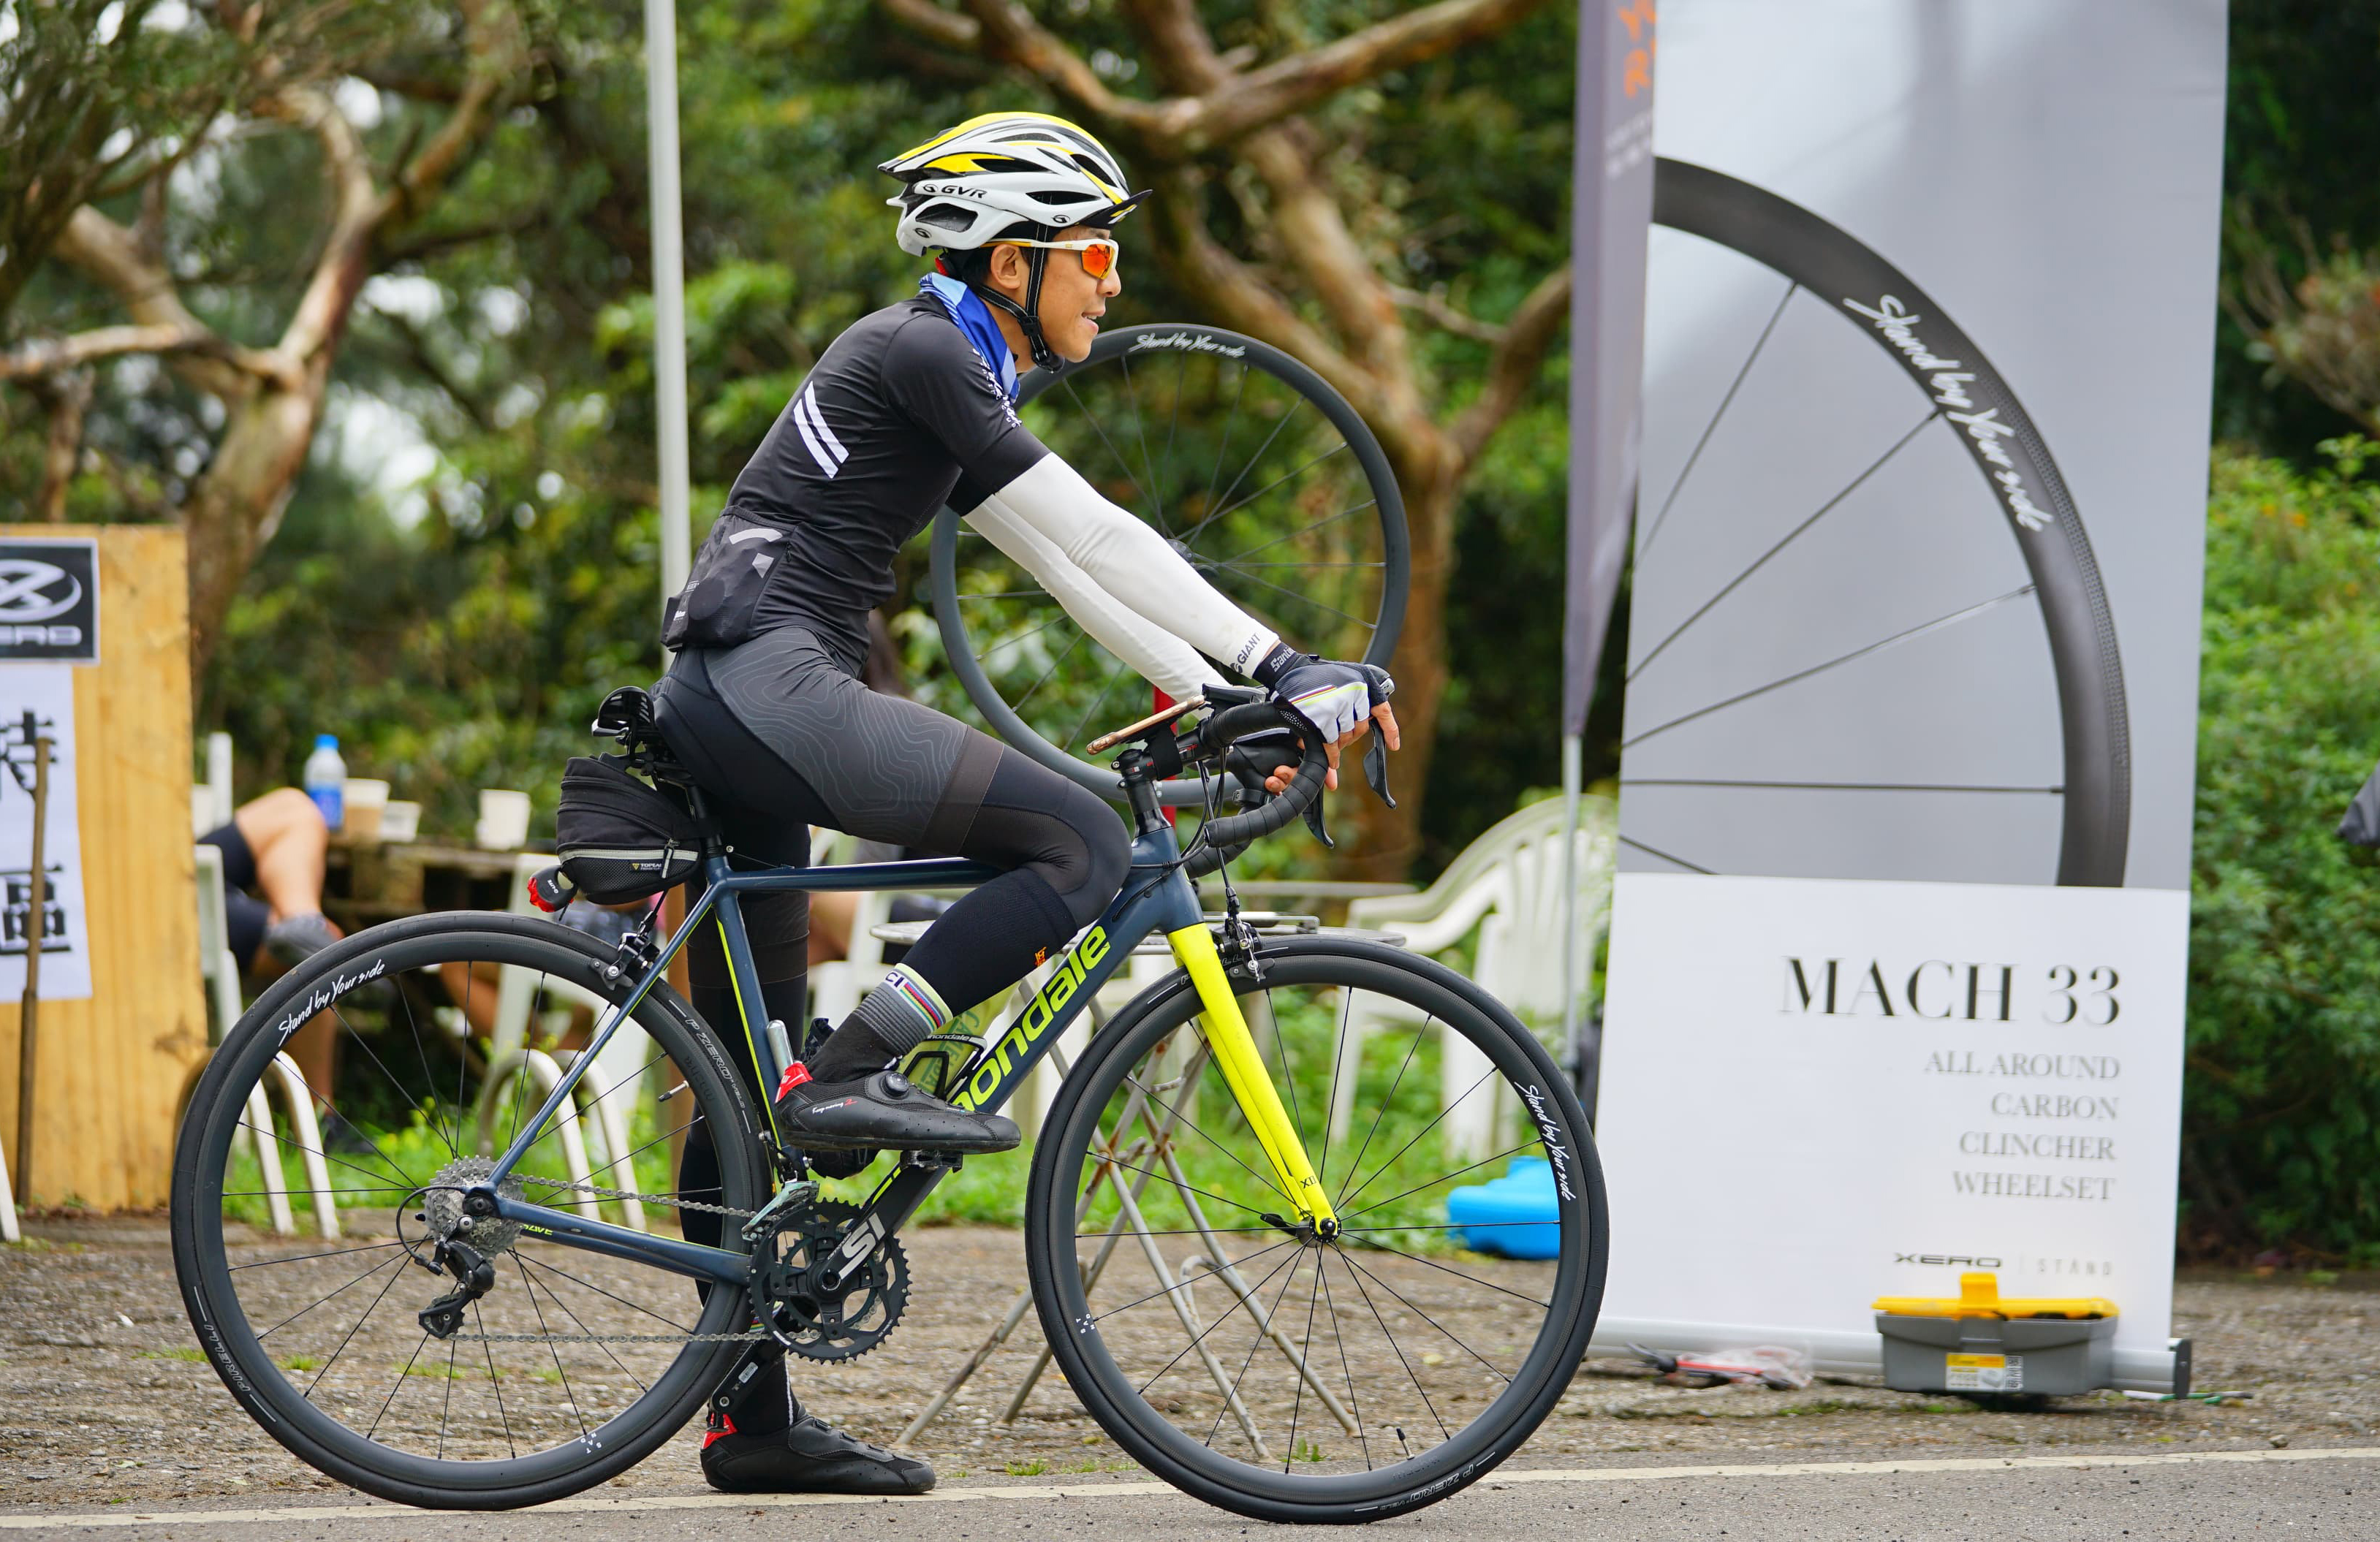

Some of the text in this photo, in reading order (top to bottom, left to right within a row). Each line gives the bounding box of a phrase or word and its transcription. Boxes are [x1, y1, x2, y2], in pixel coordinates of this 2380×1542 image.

[941, 185, 988, 198] GVR
[1843, 295, 1961, 370] Stand
[1930, 373, 1976, 409] by
[1947, 407, 2015, 468] Your
[1238, 632, 1260, 664] GIANT
[1777, 955, 2120, 1025] MACH 33
[278, 996, 313, 1047] Stand
[314, 990, 330, 1009] by
[331, 974, 357, 1003] Your
[1924, 1050, 2120, 1080] ALL AROUND
[1514, 1081, 1556, 1125] Stand
[1990, 1092, 2120, 1120] CARBON
[1542, 1123, 1561, 1142] by
[1959, 1131, 2118, 1161] CLINCHER
[1545, 1141, 1570, 1171] Your
[1952, 1171, 2117, 1200] WHEELSET
[1894, 1252, 2112, 1276] XERO STAND
[204, 1323, 251, 1392] PIRELLI
